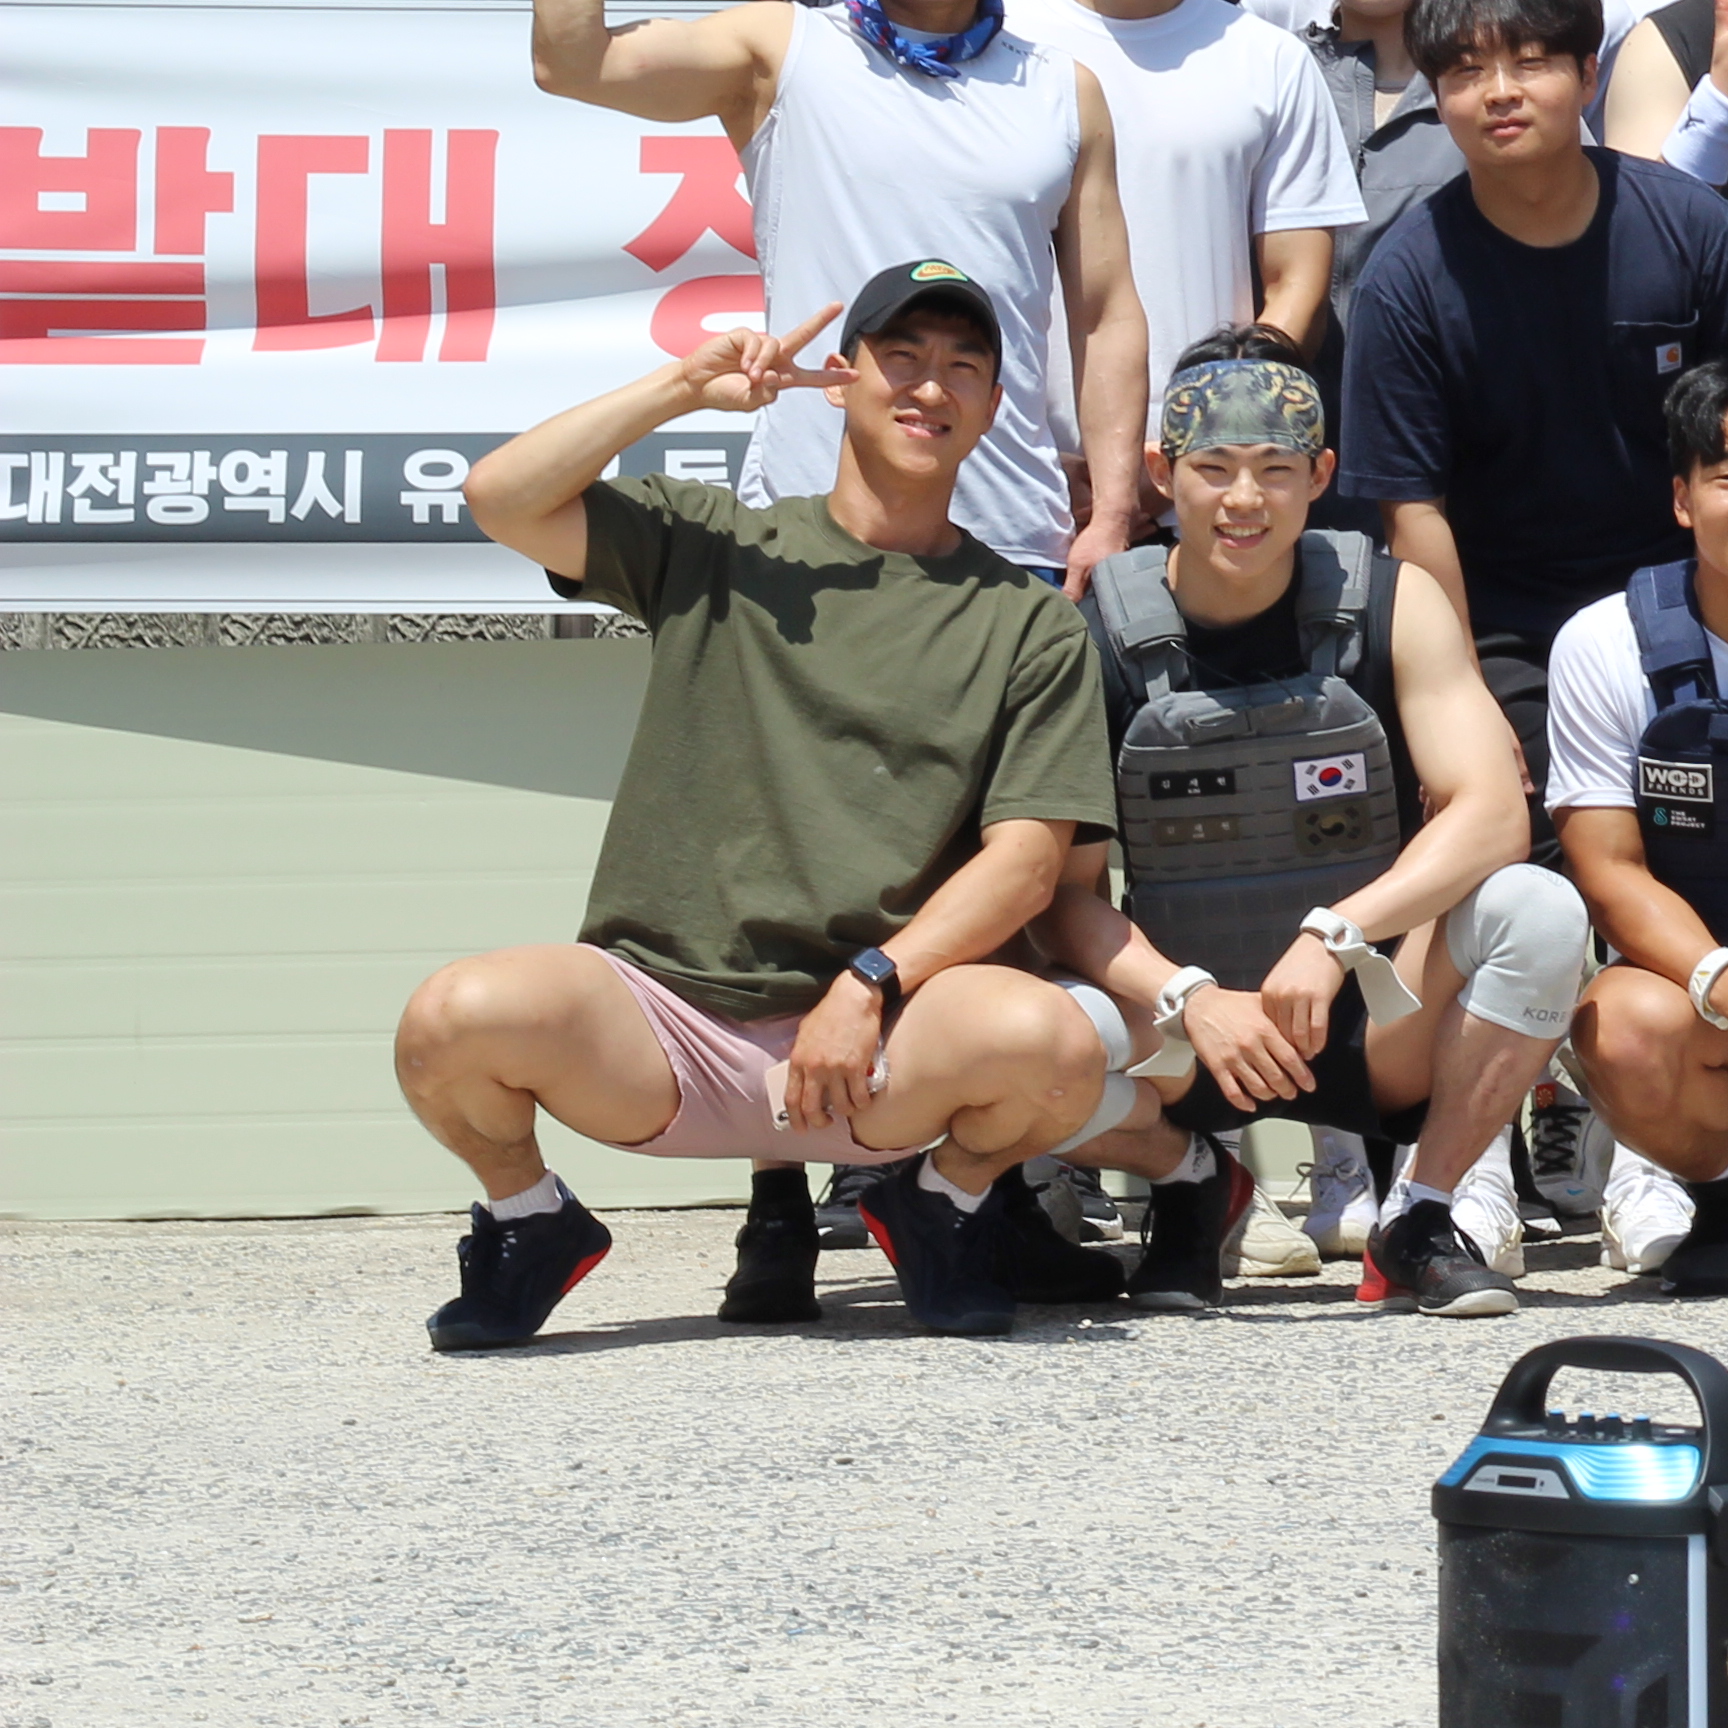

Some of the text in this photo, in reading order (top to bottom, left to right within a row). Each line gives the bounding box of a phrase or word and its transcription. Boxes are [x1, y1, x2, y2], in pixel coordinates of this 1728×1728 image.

[0, 448, 362, 524] 대전광역시
[1645, 766, 1706, 788] WOD
[1648, 783, 1704, 795] FRIENDS
